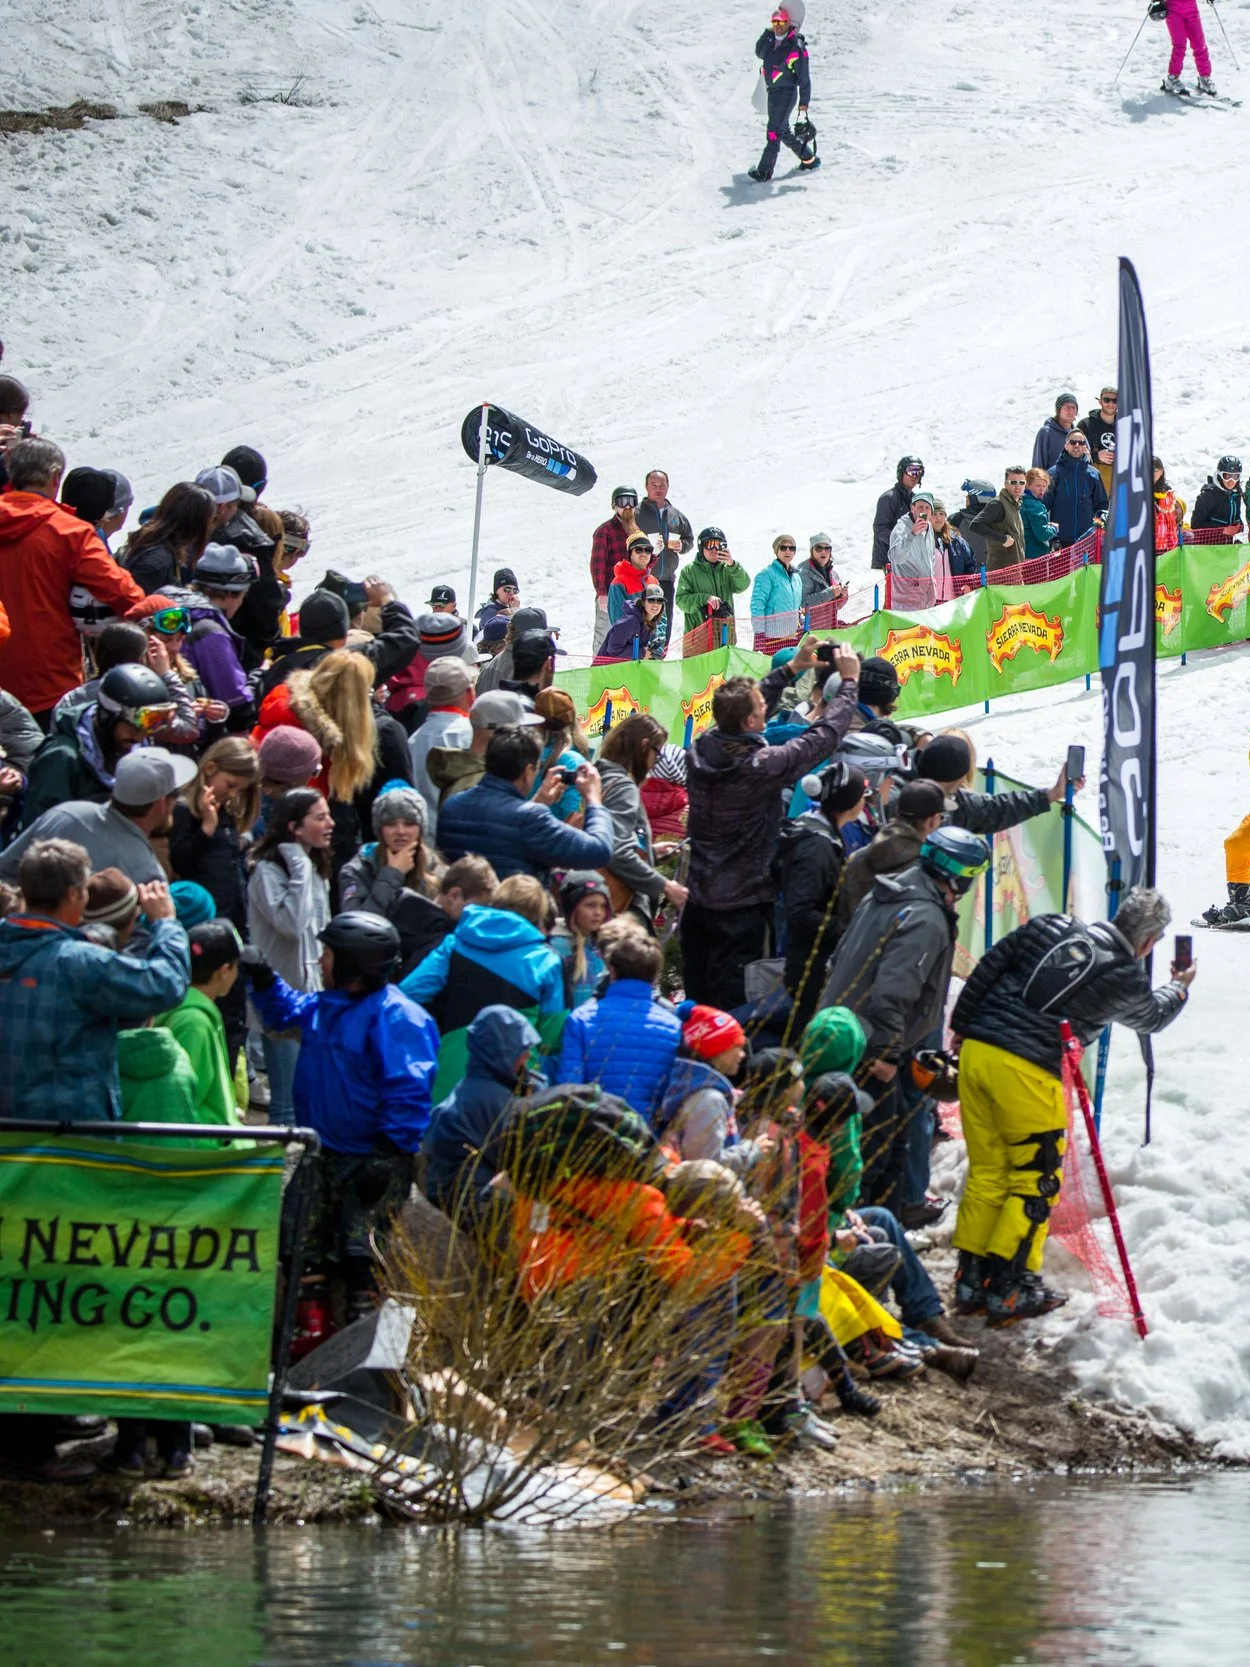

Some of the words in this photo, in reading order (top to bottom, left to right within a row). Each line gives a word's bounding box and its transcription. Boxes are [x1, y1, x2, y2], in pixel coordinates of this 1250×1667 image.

[524, 427, 577, 466] GoPro
[996, 623, 1019, 649] SIERRA
[1018, 622, 1048, 639] NEVADA
[890, 648, 910, 667] ERRA
[911, 645, 950, 662] NEVADA
[694, 700, 713, 722] SIER
[17, 1215, 261, 1273] NEVADA
[0, 1276, 109, 1334] ING
[120, 1285, 212, 1332] CO.
